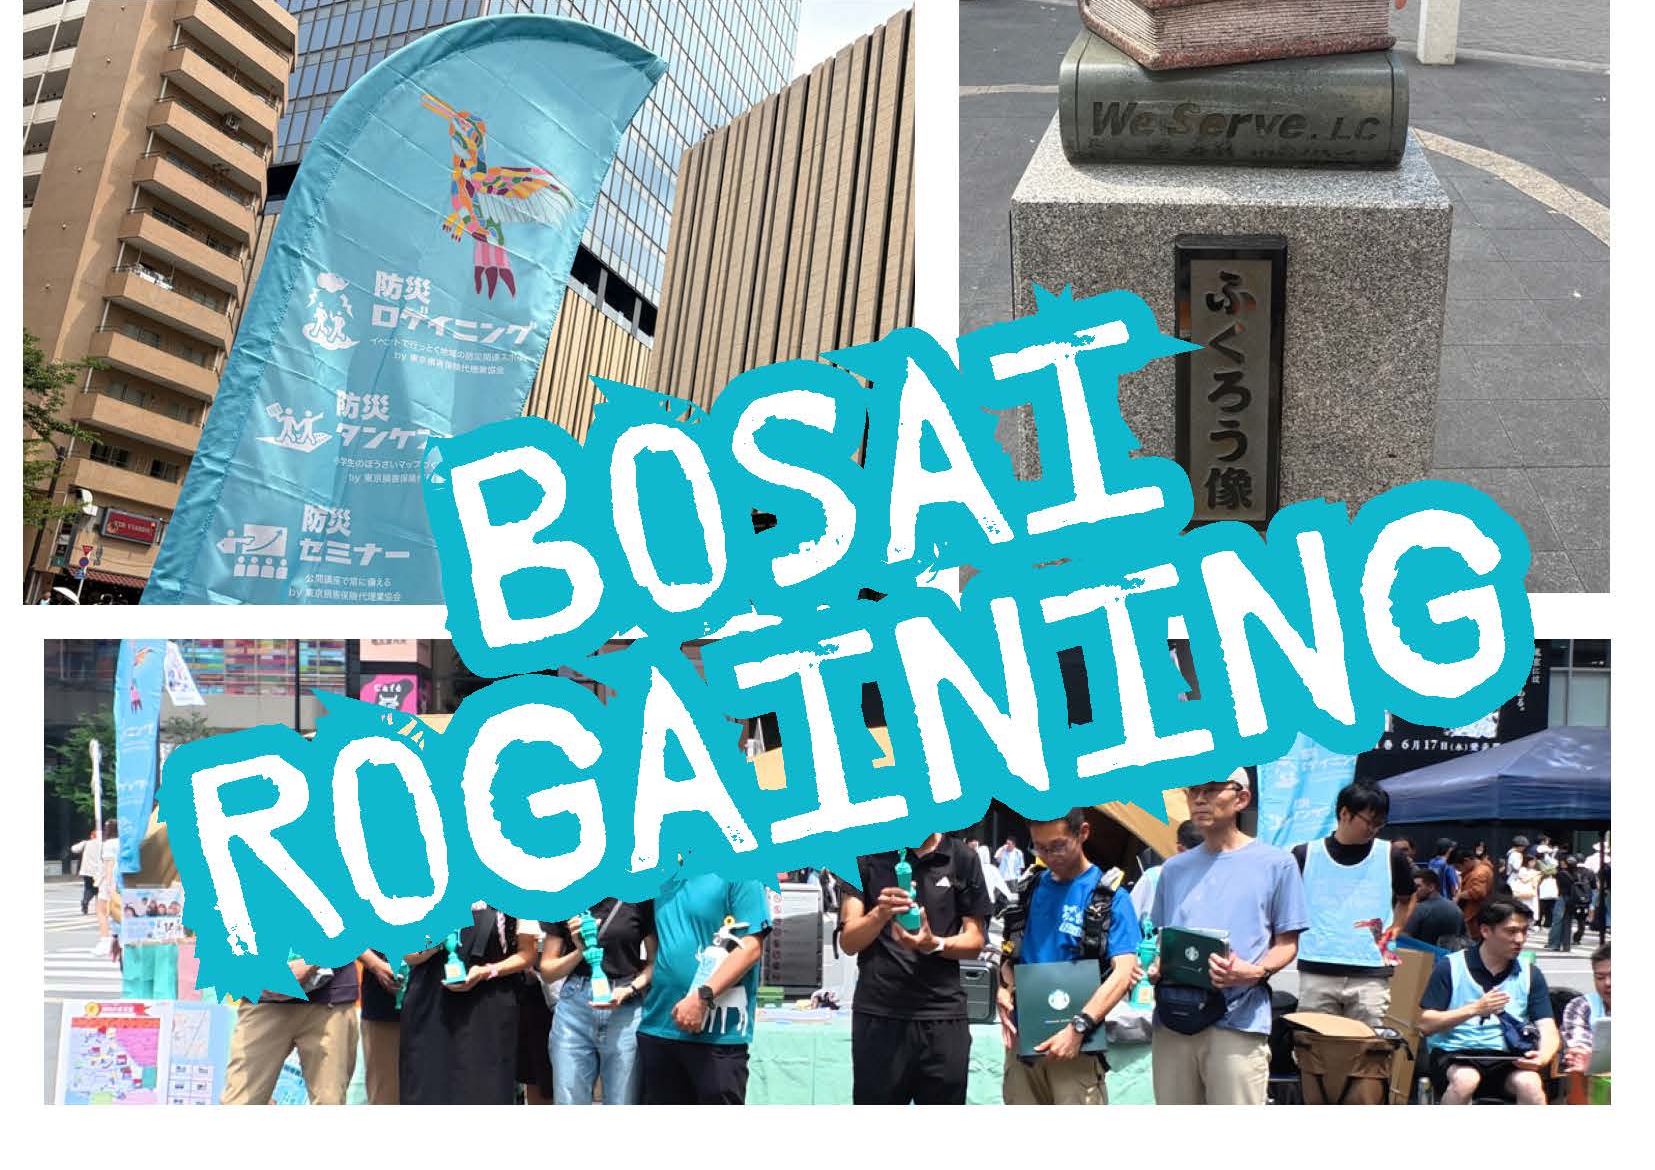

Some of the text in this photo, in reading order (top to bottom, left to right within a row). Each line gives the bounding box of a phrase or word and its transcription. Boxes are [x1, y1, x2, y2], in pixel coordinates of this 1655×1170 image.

[1092, 102, 1156, 138] We
[374, 270, 432, 305] 防災
[371, 303, 538, 345] ロゲイニング
[335, 389, 390, 422] 防災
[1205, 270, 1257, 511] ふくろう像
[303, 504, 351, 536] 防災
[300, 538, 410, 567] セミナー
